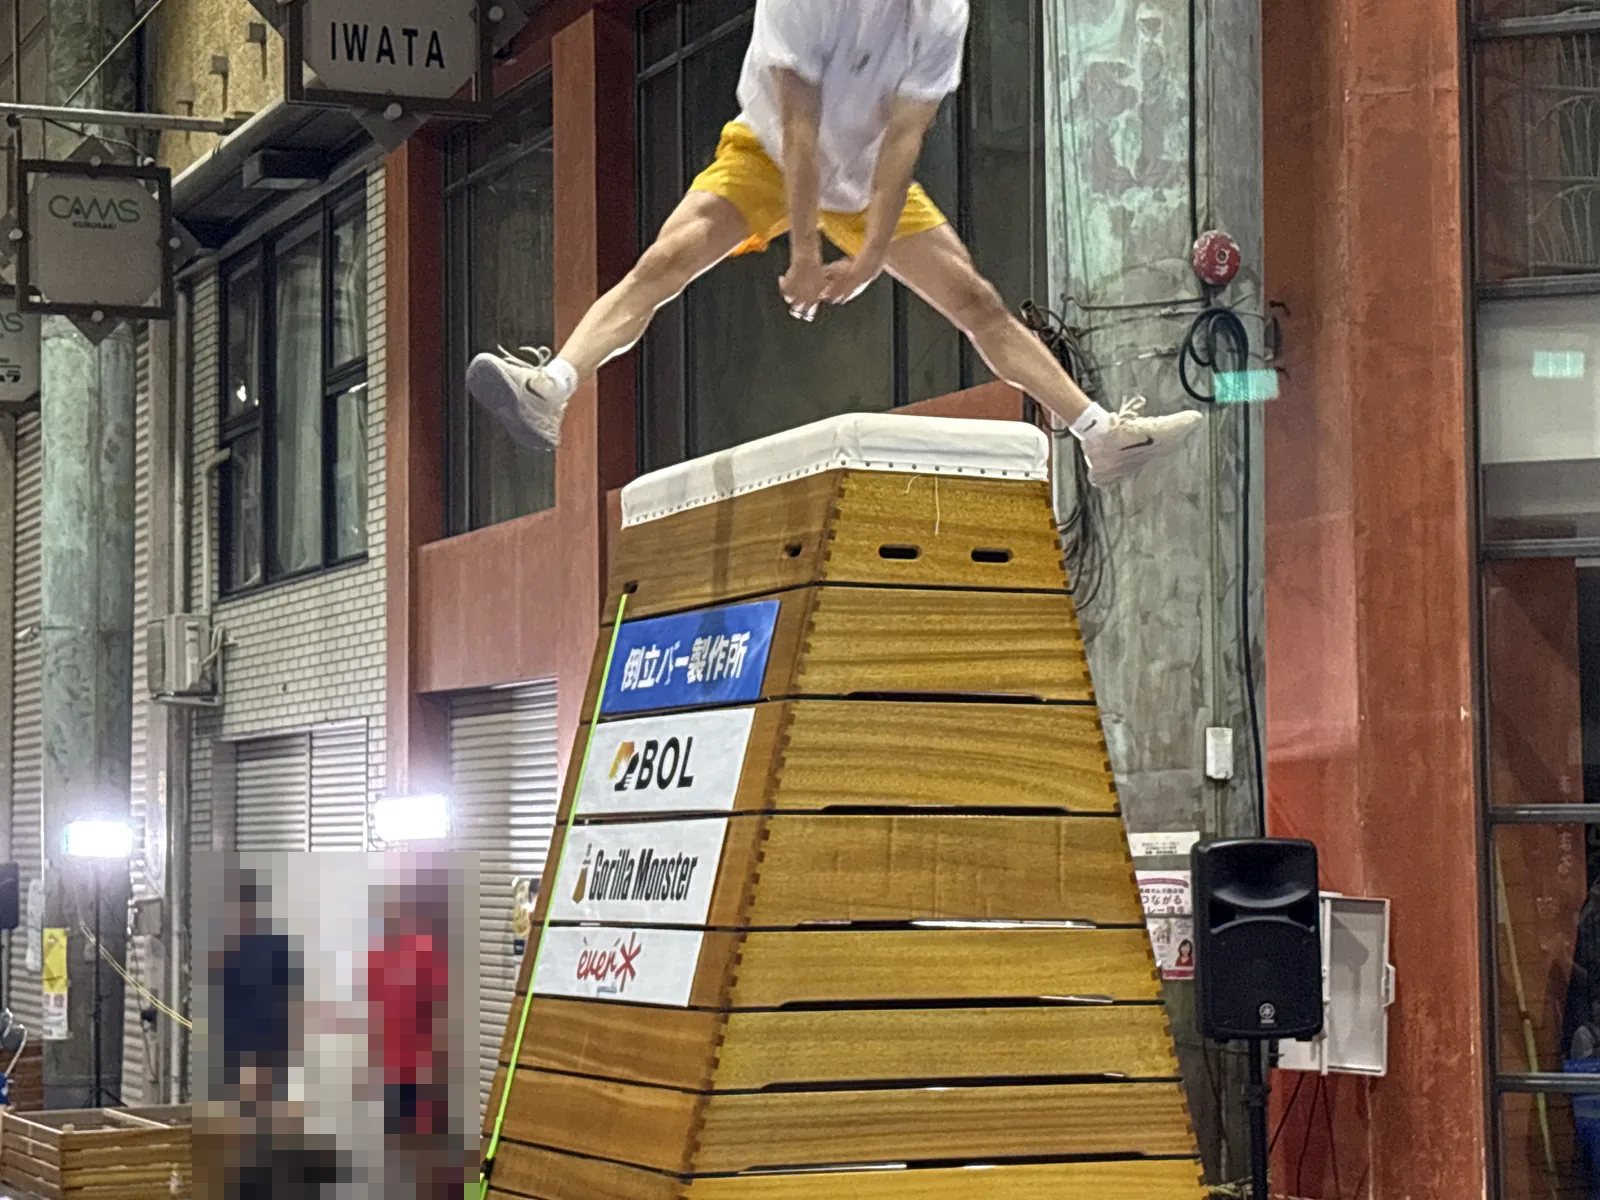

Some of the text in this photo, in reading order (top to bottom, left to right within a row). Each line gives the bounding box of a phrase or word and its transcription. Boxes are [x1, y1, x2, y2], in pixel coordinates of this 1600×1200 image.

[330, 21, 446, 69] IWATA
[620, 630, 751, 692] 倒立バー製作所
[634, 736, 694, 790] BOL
[588, 848, 699, 902] Gorilla Monster
